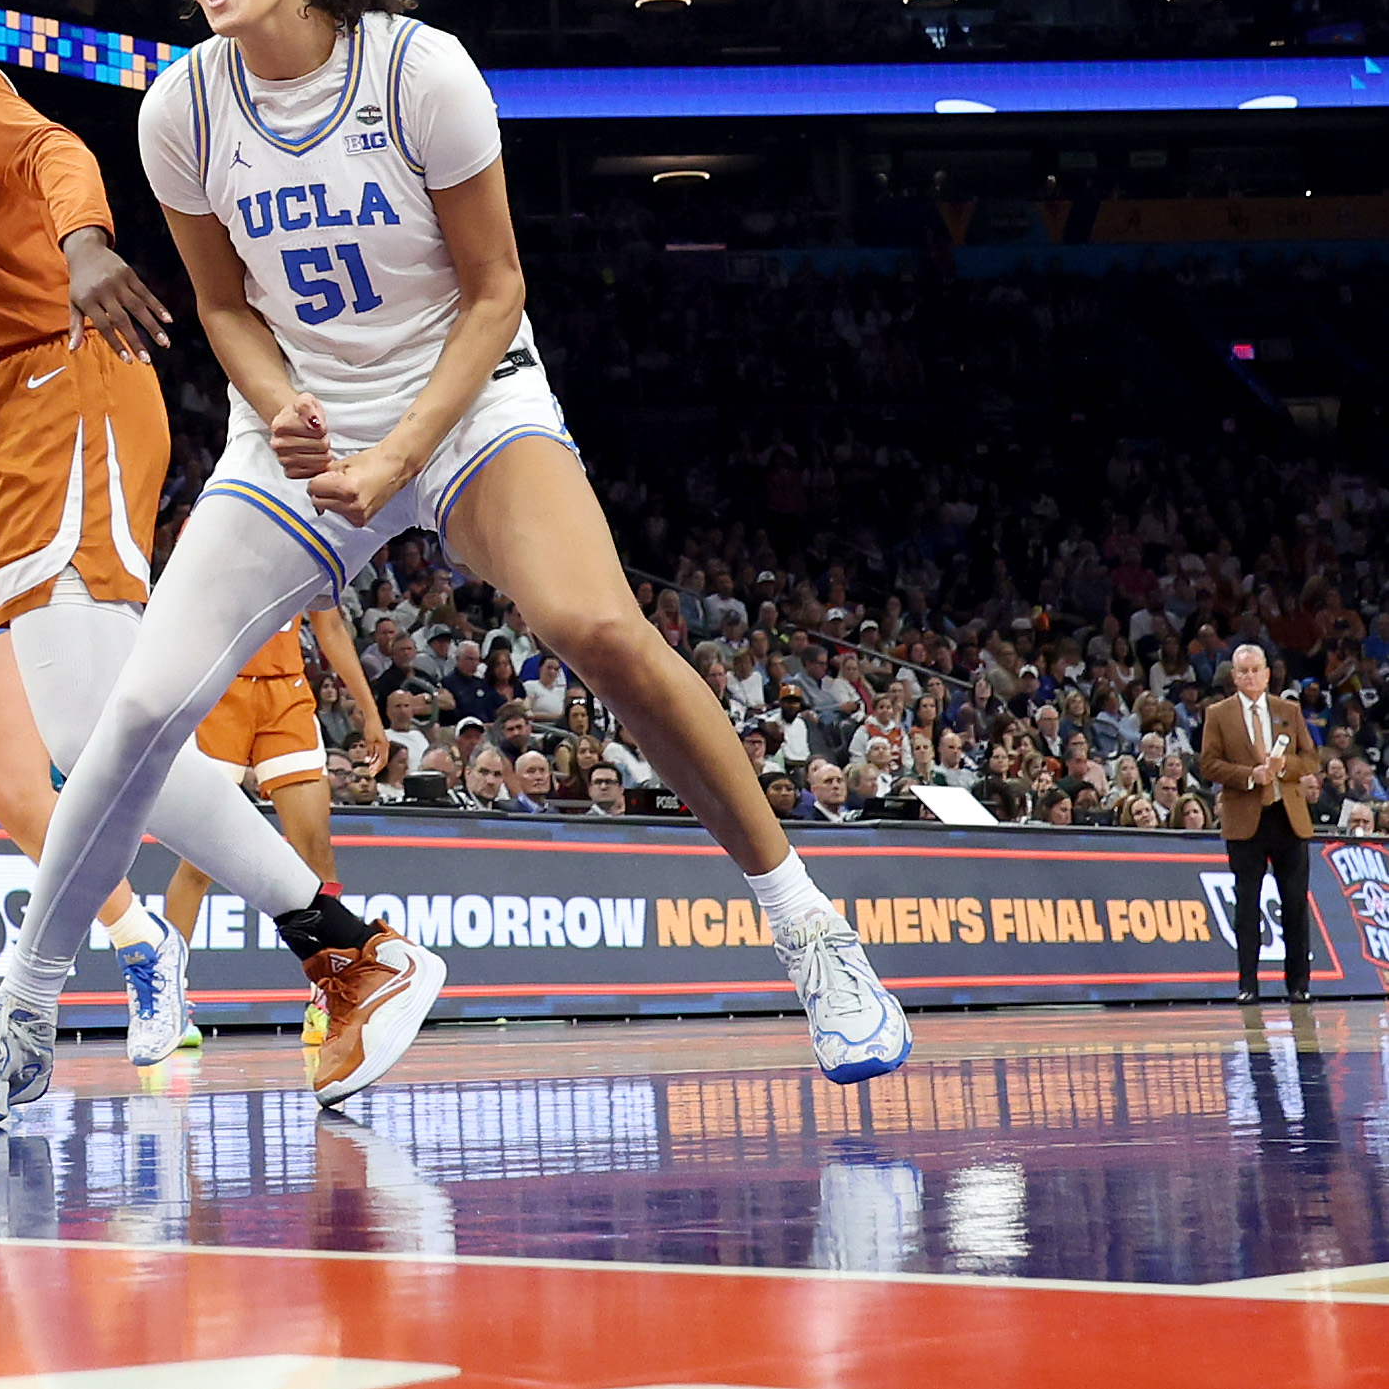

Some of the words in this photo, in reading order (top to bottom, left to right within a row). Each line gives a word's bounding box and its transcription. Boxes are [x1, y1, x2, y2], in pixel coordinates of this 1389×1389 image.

[237, 181, 401, 239] UCLA
[280, 242, 383, 325] 51
[855, 896, 986, 945] MEN'S
[990, 897, 1104, 945] FINAL
[1105, 898, 1211, 943] FOUR
